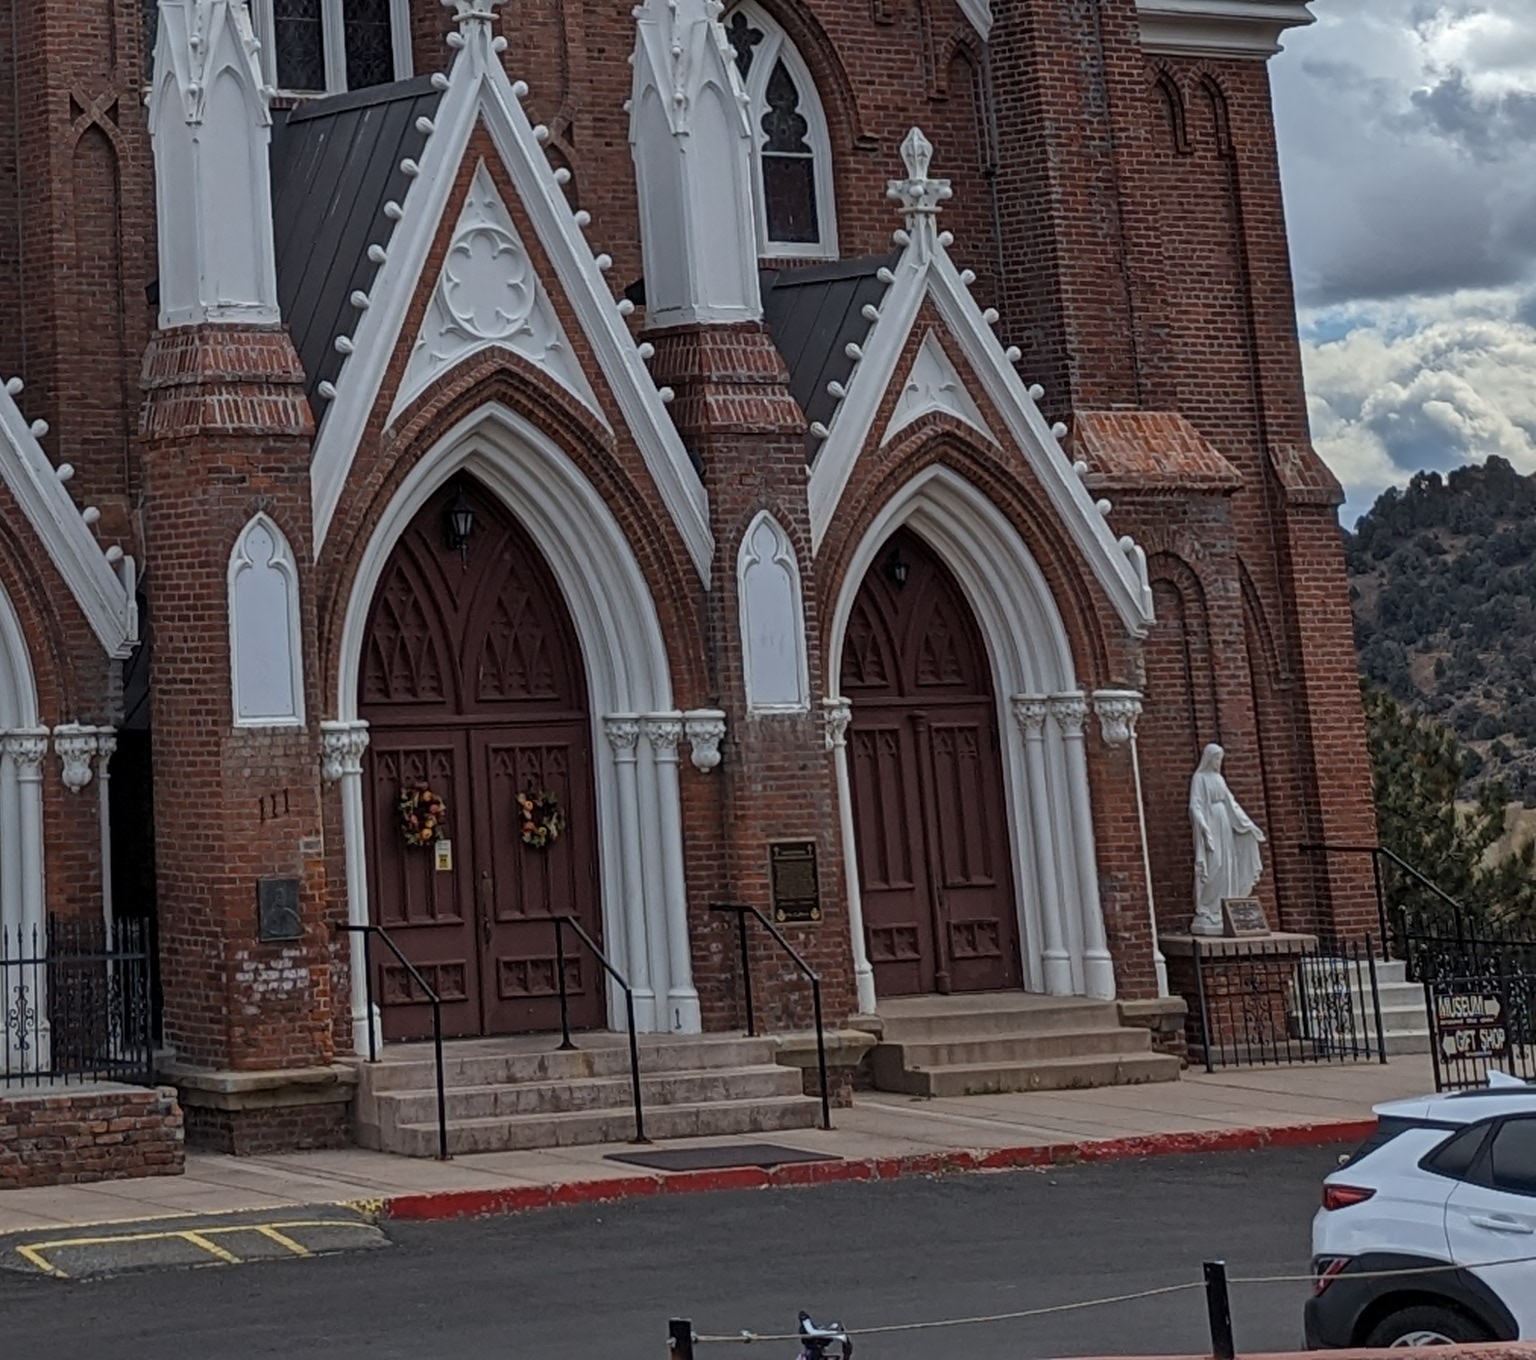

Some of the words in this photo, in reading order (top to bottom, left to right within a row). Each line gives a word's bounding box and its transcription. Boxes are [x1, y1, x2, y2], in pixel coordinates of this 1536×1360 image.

[1438, 995, 1484, 1018] MUSEUM
[1456, 1029, 1476, 1051] GIFT
[1480, 1027, 1506, 1051] SHOP
